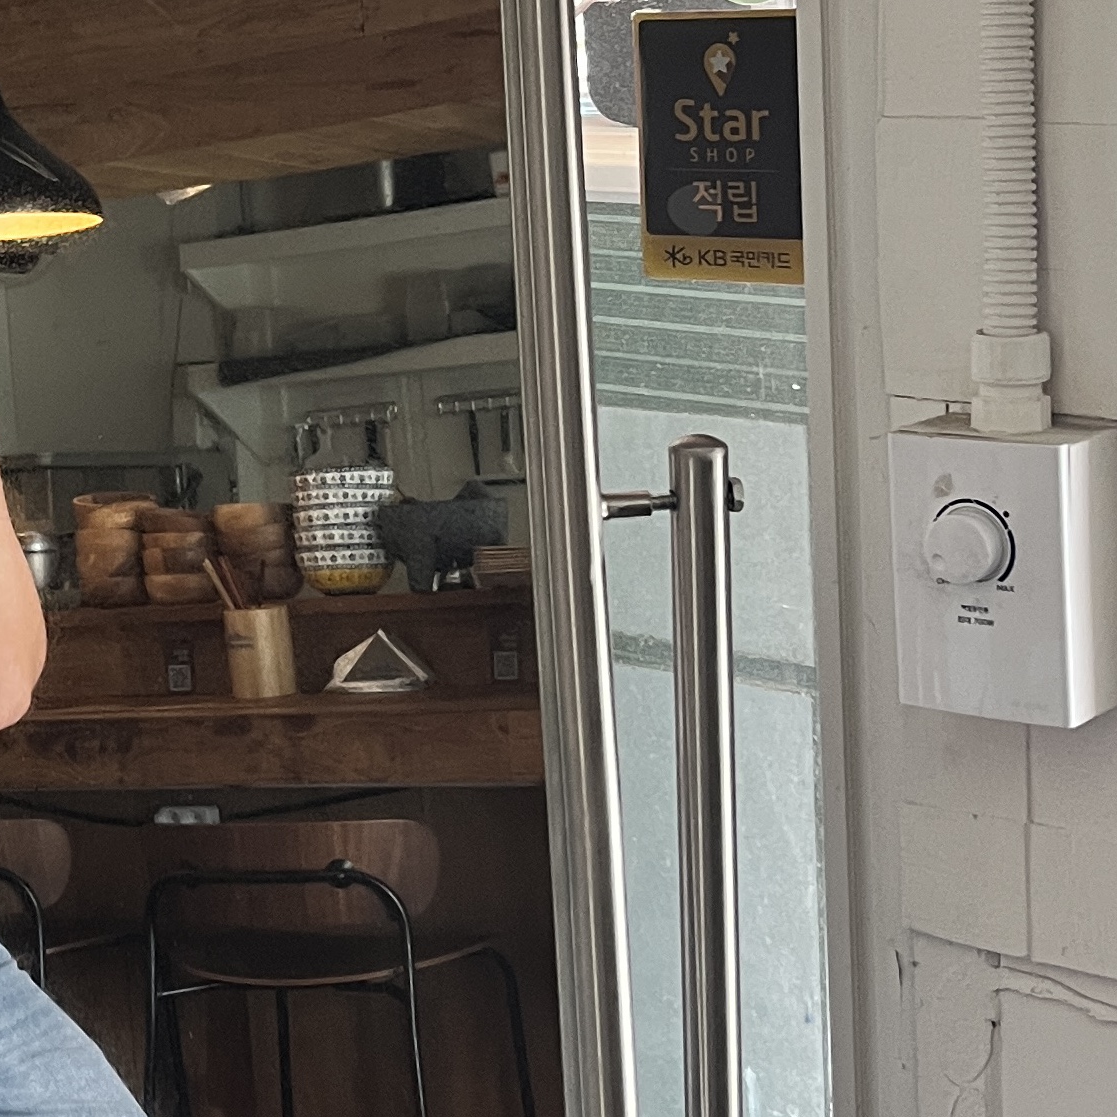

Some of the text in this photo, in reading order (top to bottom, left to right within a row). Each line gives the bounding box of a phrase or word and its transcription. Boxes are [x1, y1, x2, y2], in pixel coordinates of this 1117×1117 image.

[674, 98, 770, 142] Star
[689, 147, 755, 163] SHOP
[692, 179, 758, 223] 적립
